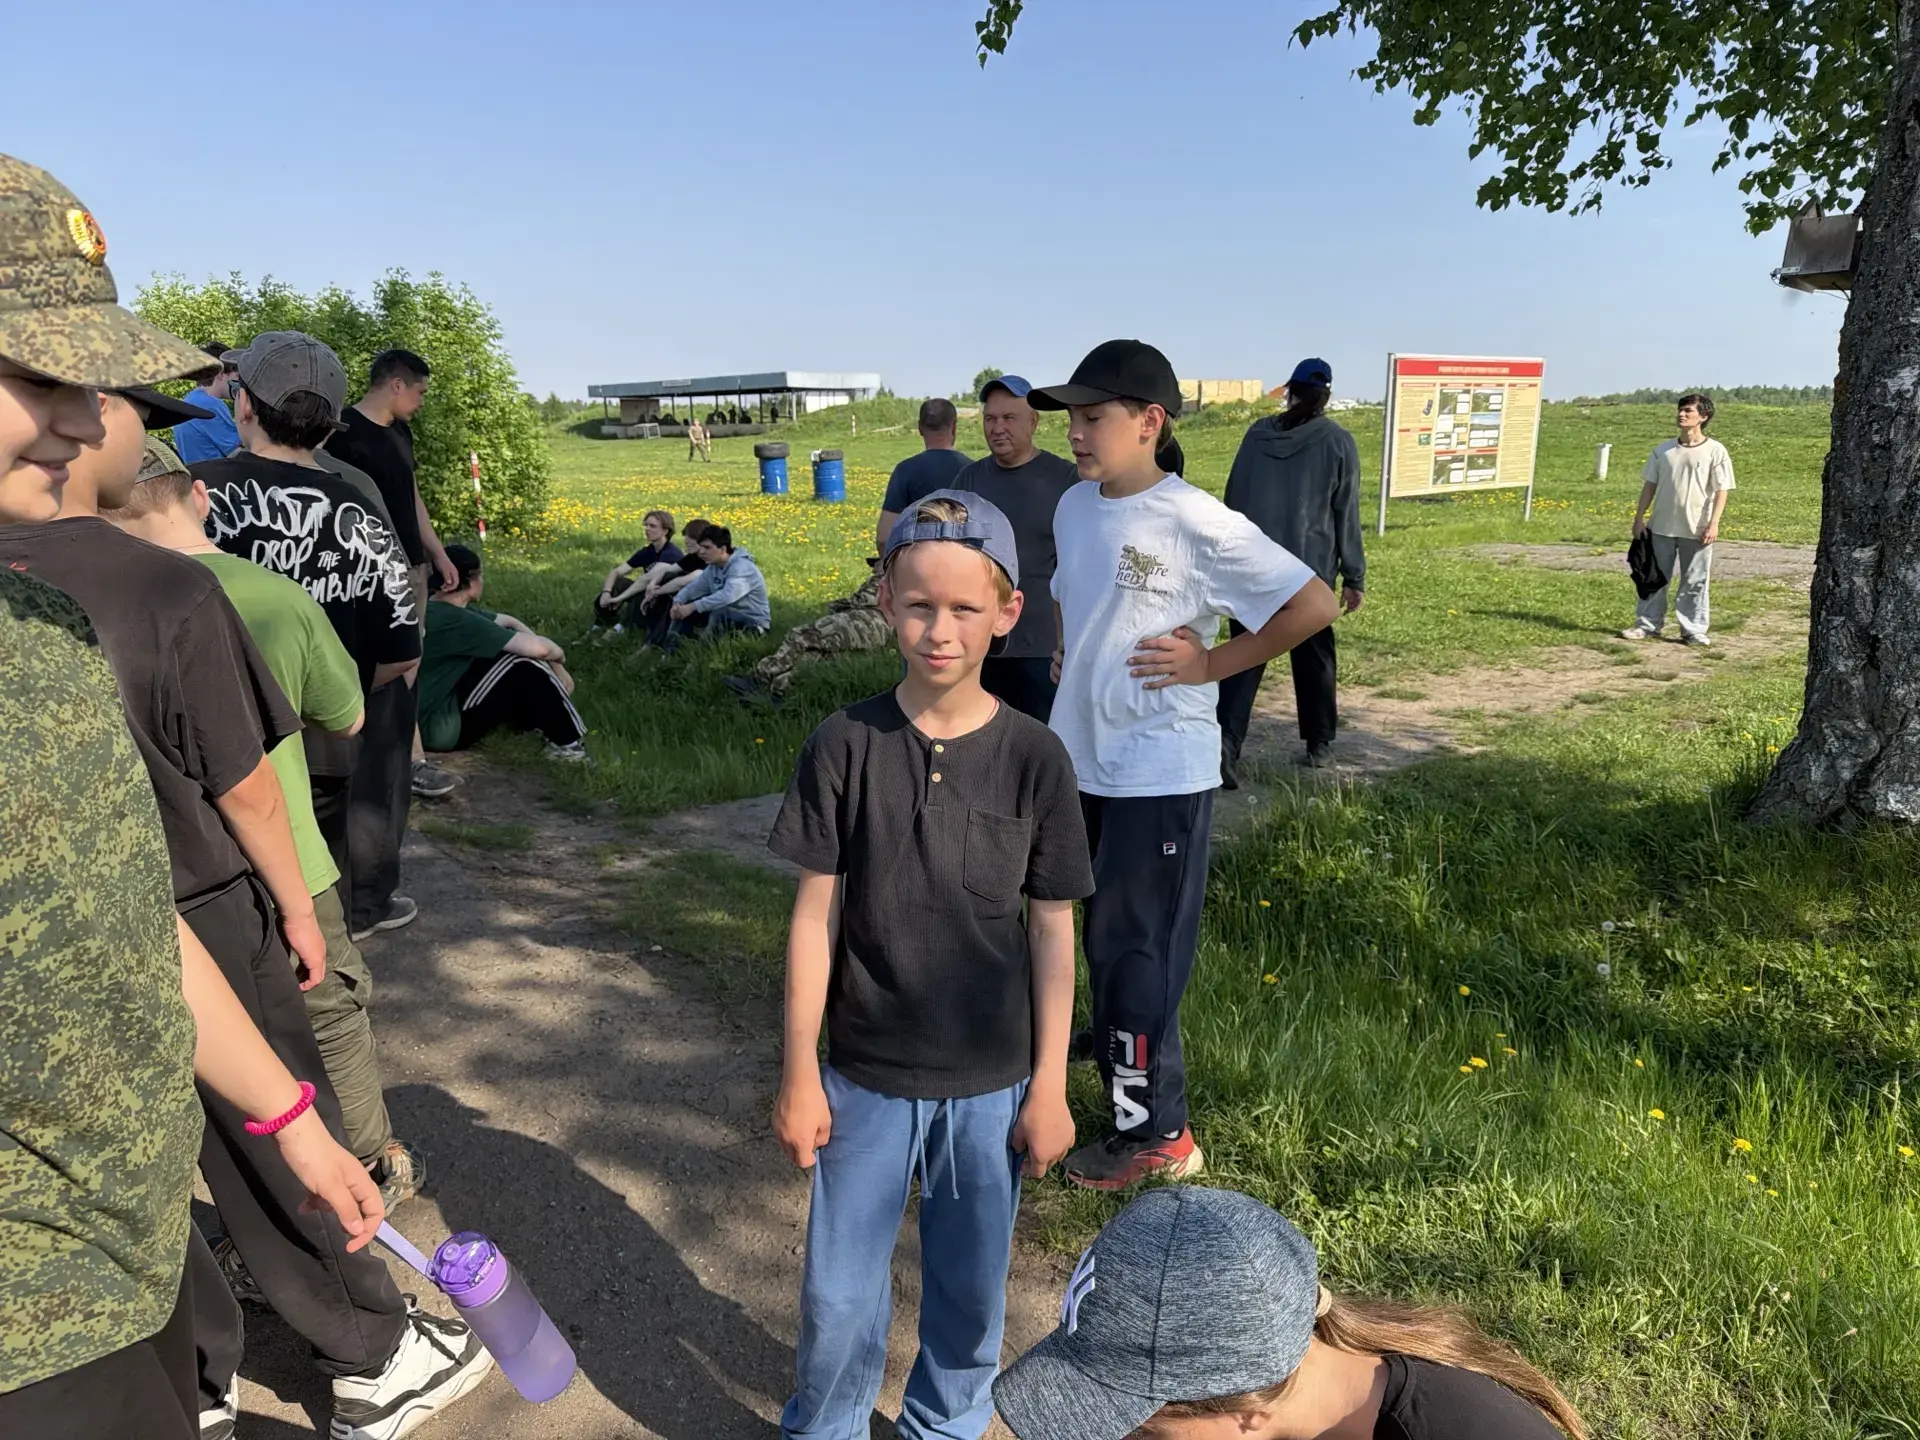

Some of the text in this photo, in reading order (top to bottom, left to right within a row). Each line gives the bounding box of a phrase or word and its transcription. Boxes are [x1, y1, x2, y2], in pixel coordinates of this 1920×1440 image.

[251, 538, 341, 580] DROP THE
[1112, 1029, 1149, 1131] FILA
